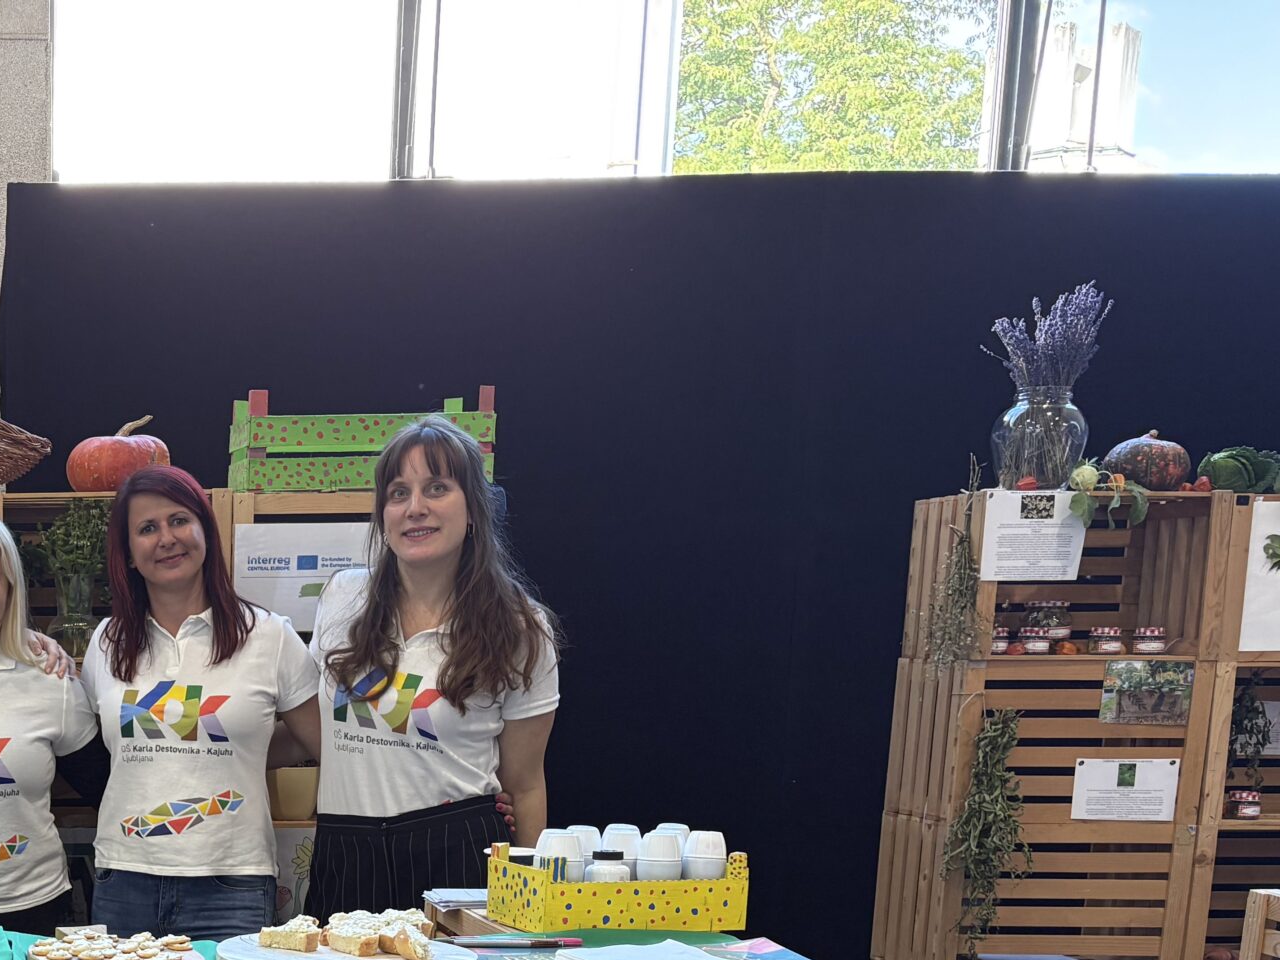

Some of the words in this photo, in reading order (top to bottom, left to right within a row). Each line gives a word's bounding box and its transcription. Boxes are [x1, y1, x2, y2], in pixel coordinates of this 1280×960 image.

[344, 732, 364, 743] Karla
[366, 735, 410, 749] Destovnika
[132, 744, 153, 753] Karla
[155, 745, 200, 755] Destovnika
[207, 748, 234, 757] Kajuha
